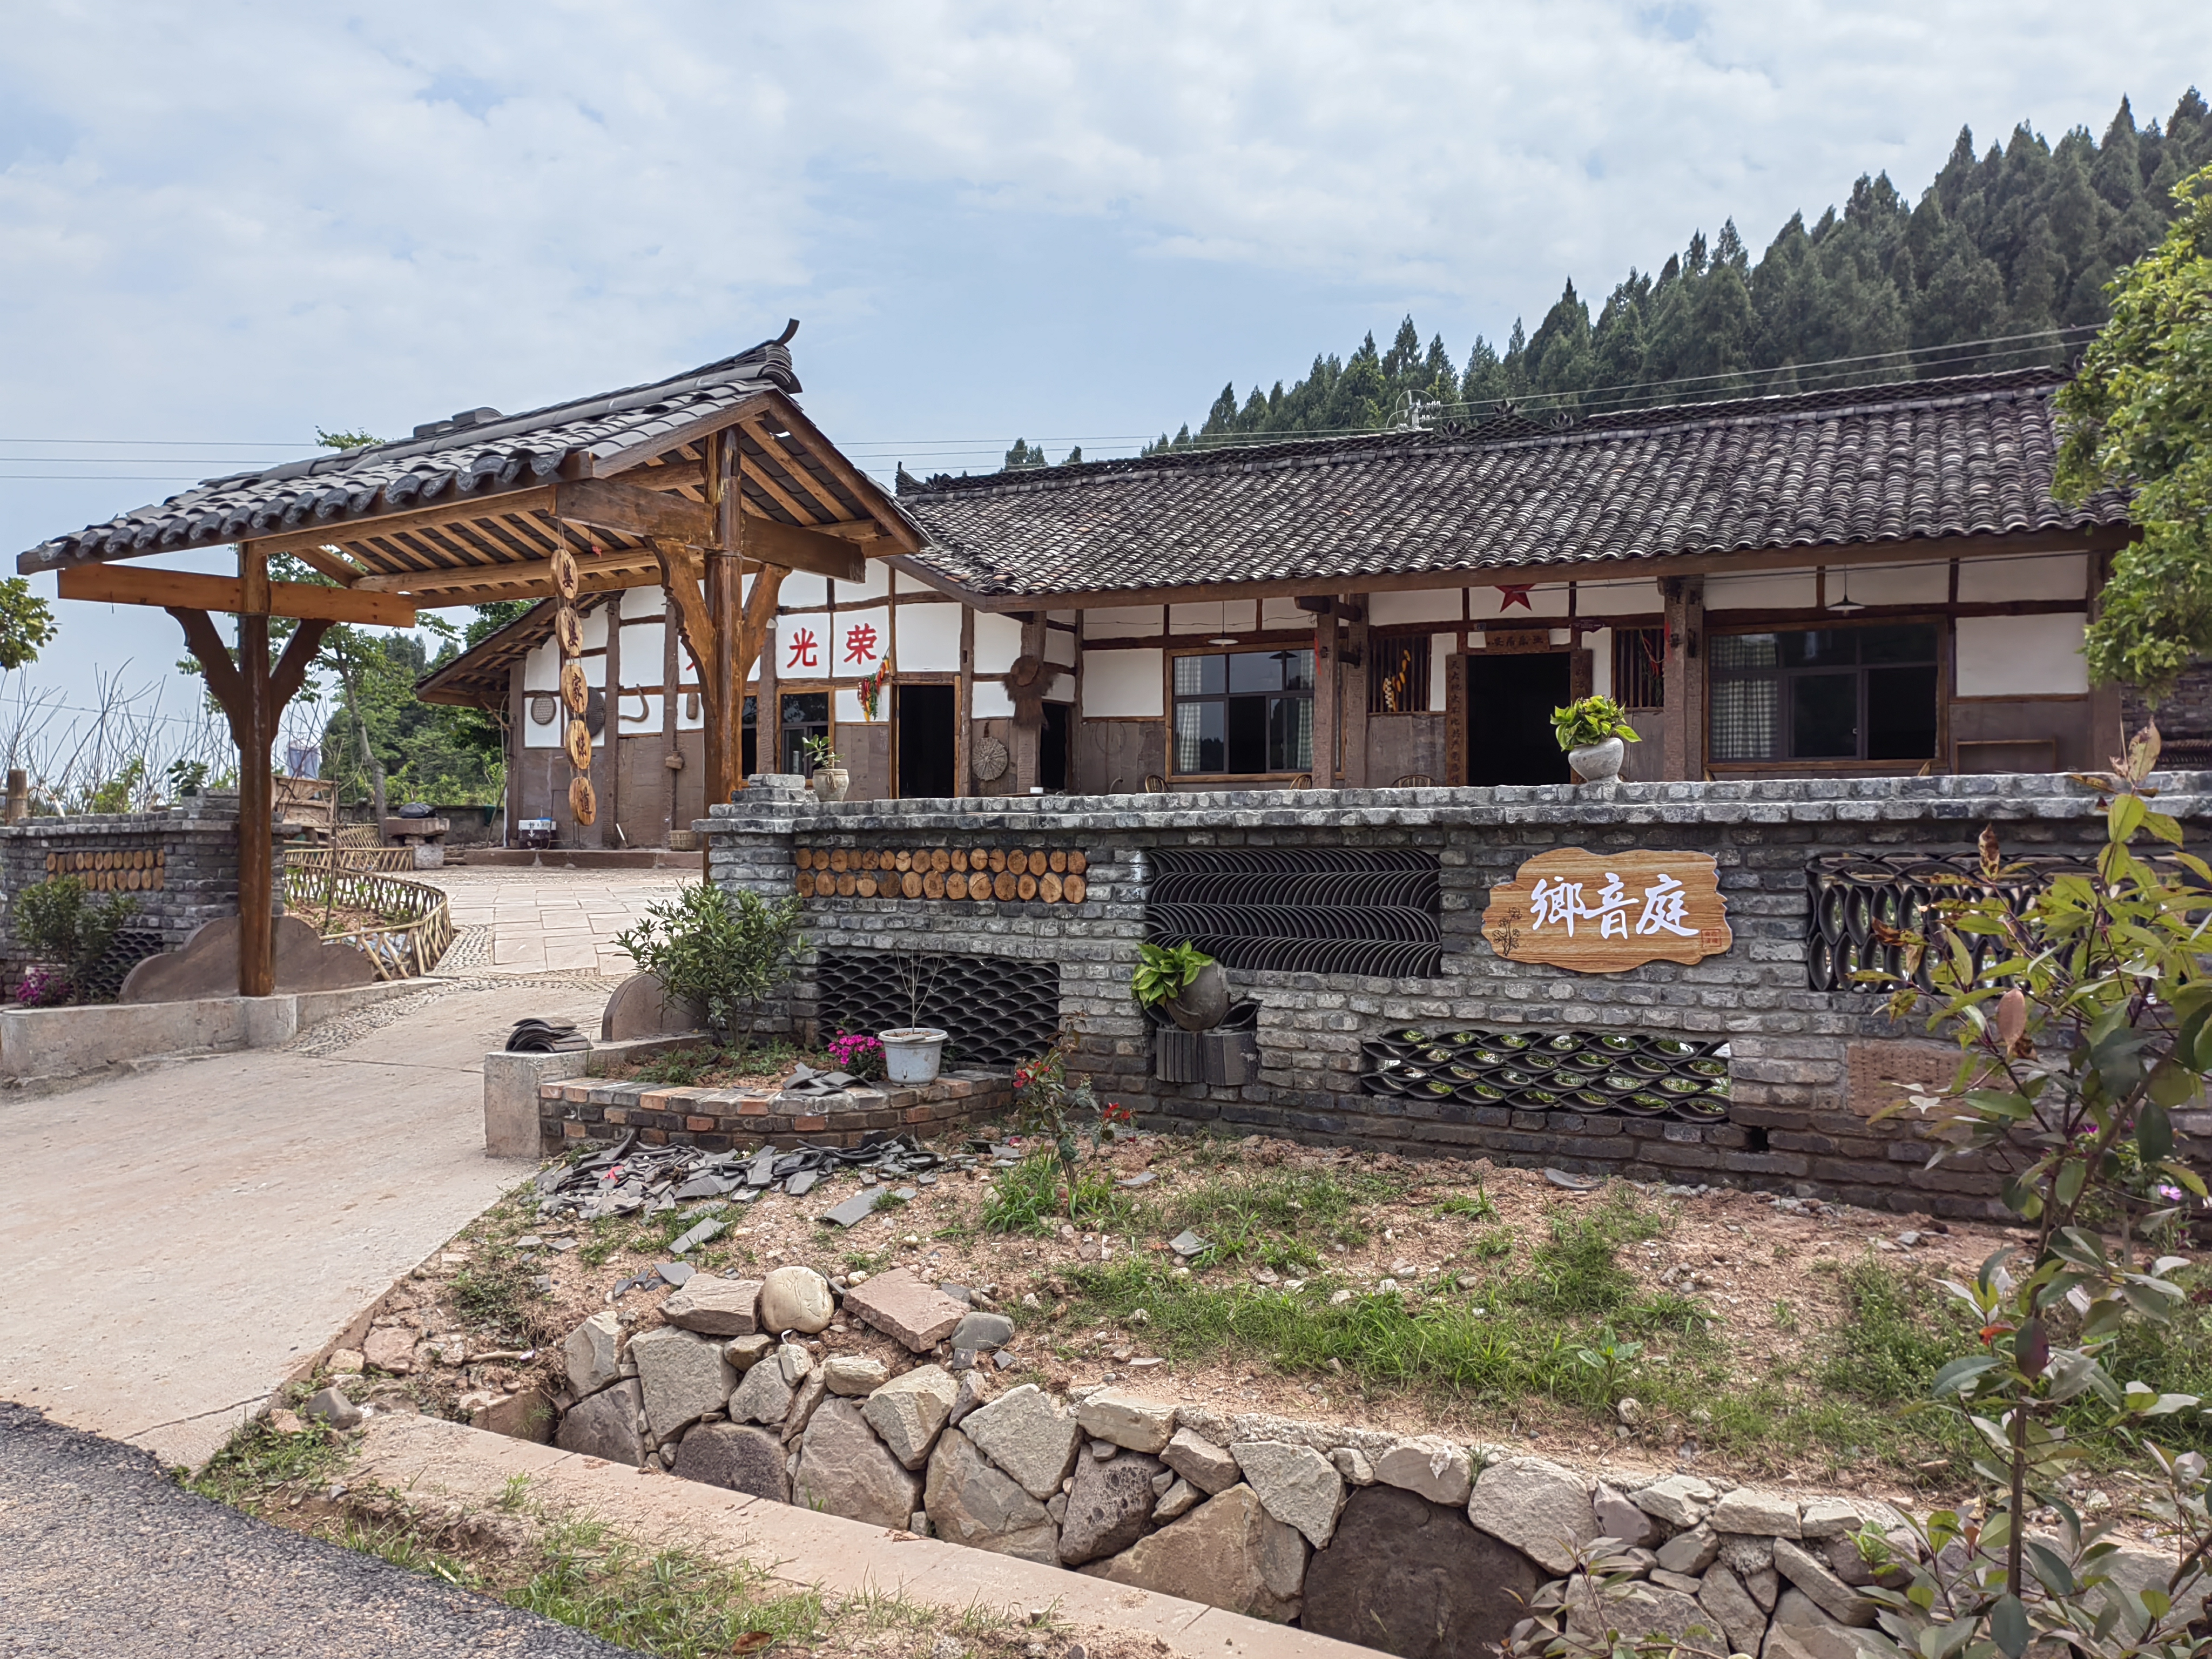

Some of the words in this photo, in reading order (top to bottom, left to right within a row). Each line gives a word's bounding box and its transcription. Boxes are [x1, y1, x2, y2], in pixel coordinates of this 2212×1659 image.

[786, 623, 878, 669] 光荣
[1529, 872, 1699, 940] 鄉音庭
